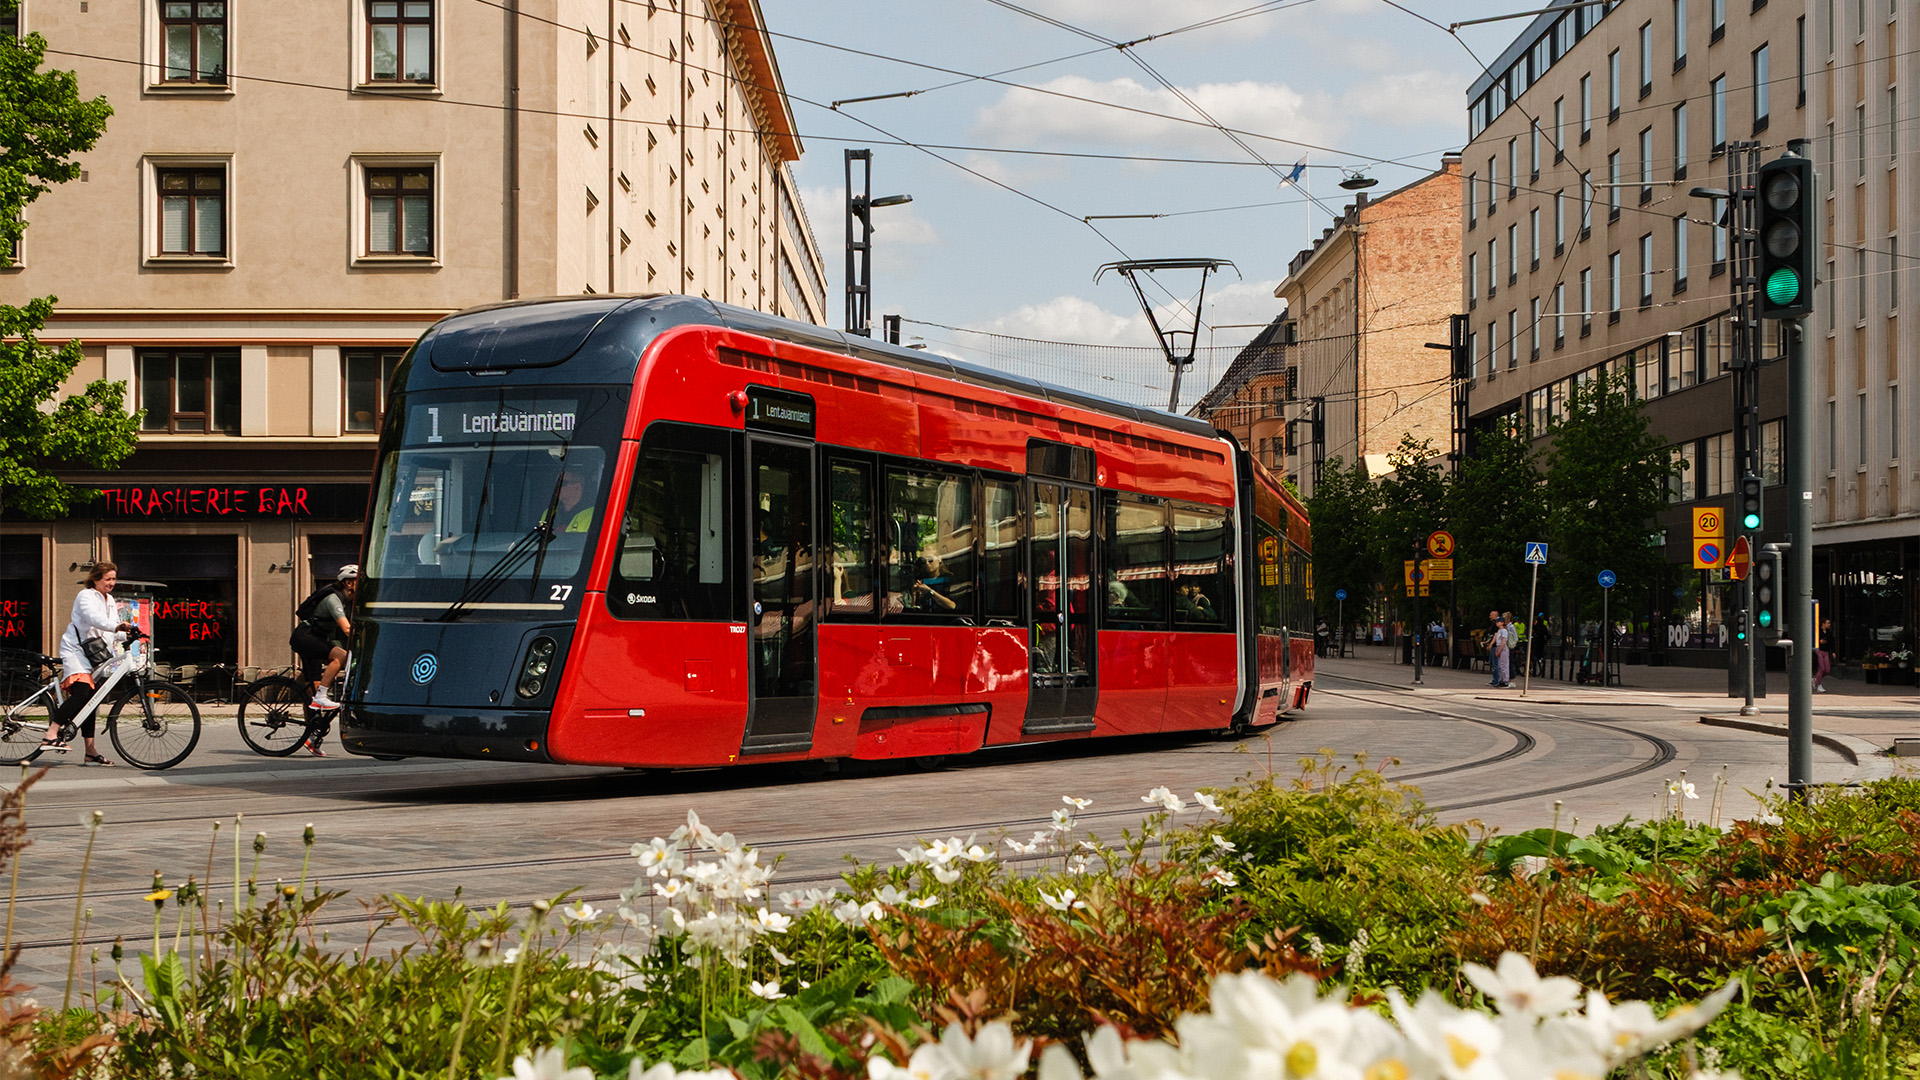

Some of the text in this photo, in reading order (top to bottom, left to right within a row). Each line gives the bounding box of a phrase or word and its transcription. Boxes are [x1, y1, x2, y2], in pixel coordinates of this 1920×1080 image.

[752, 397, 760, 420] 1
[427, 407, 443, 443] 1
[101, 487, 312, 516] THRASHERIE BAR
[1702, 517, 1716, 528] 20
[549, 584, 573, 601] 27
[189, 621, 223, 641] BAR
[1668, 624, 1690, 648] POP
[1719, 624, 1729, 649] P
